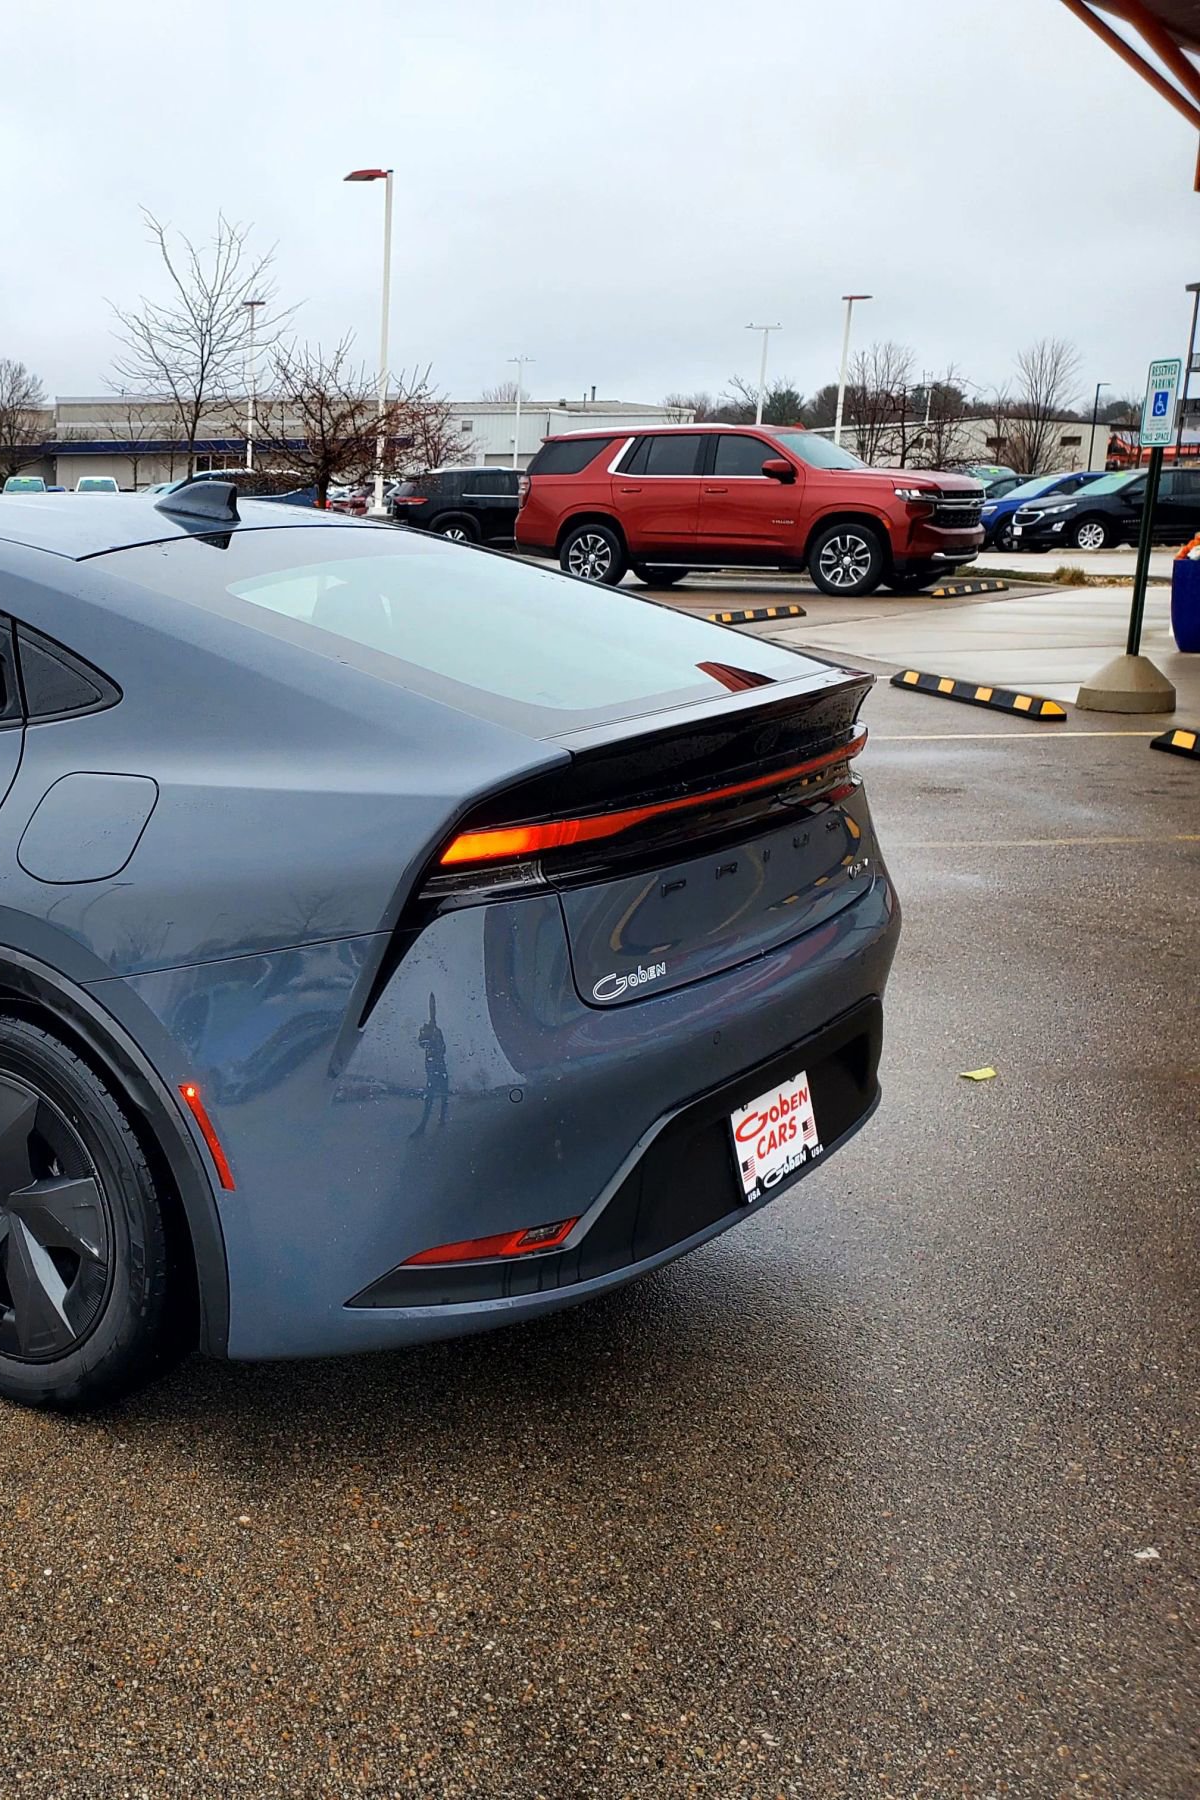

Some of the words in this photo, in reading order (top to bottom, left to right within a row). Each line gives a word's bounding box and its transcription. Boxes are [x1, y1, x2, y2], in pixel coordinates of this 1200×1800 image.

[1152, 364, 1178, 377] RESERVED
[1151, 378, 1175, 390] PARKING
[1155, 431, 1170, 442] SPACE
[756, 1115, 798, 1160] CARS
[811, 1144, 824, 1158] USA
[747, 1188, 761, 1203] USA
